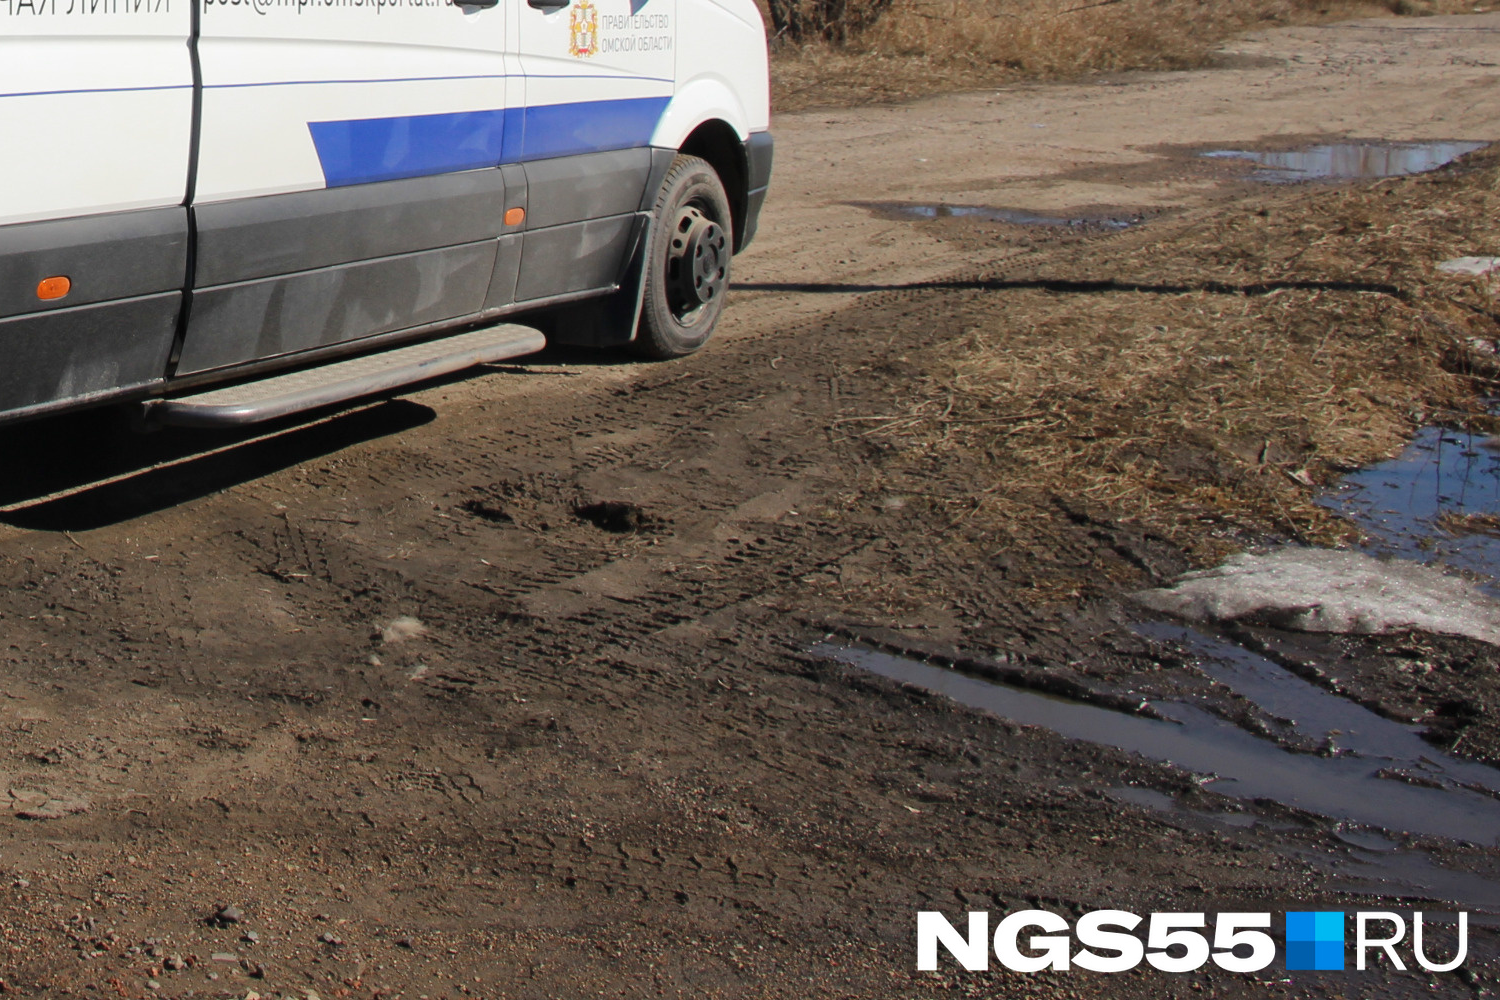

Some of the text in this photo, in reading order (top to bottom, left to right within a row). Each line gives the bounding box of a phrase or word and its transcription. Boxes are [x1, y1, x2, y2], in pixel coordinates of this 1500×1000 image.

[602, 14, 669, 30] ПРАВИТЕЛЬСТВО
[602, 34, 672, 53] ОМСКОЙ ОБЛАСТИ
